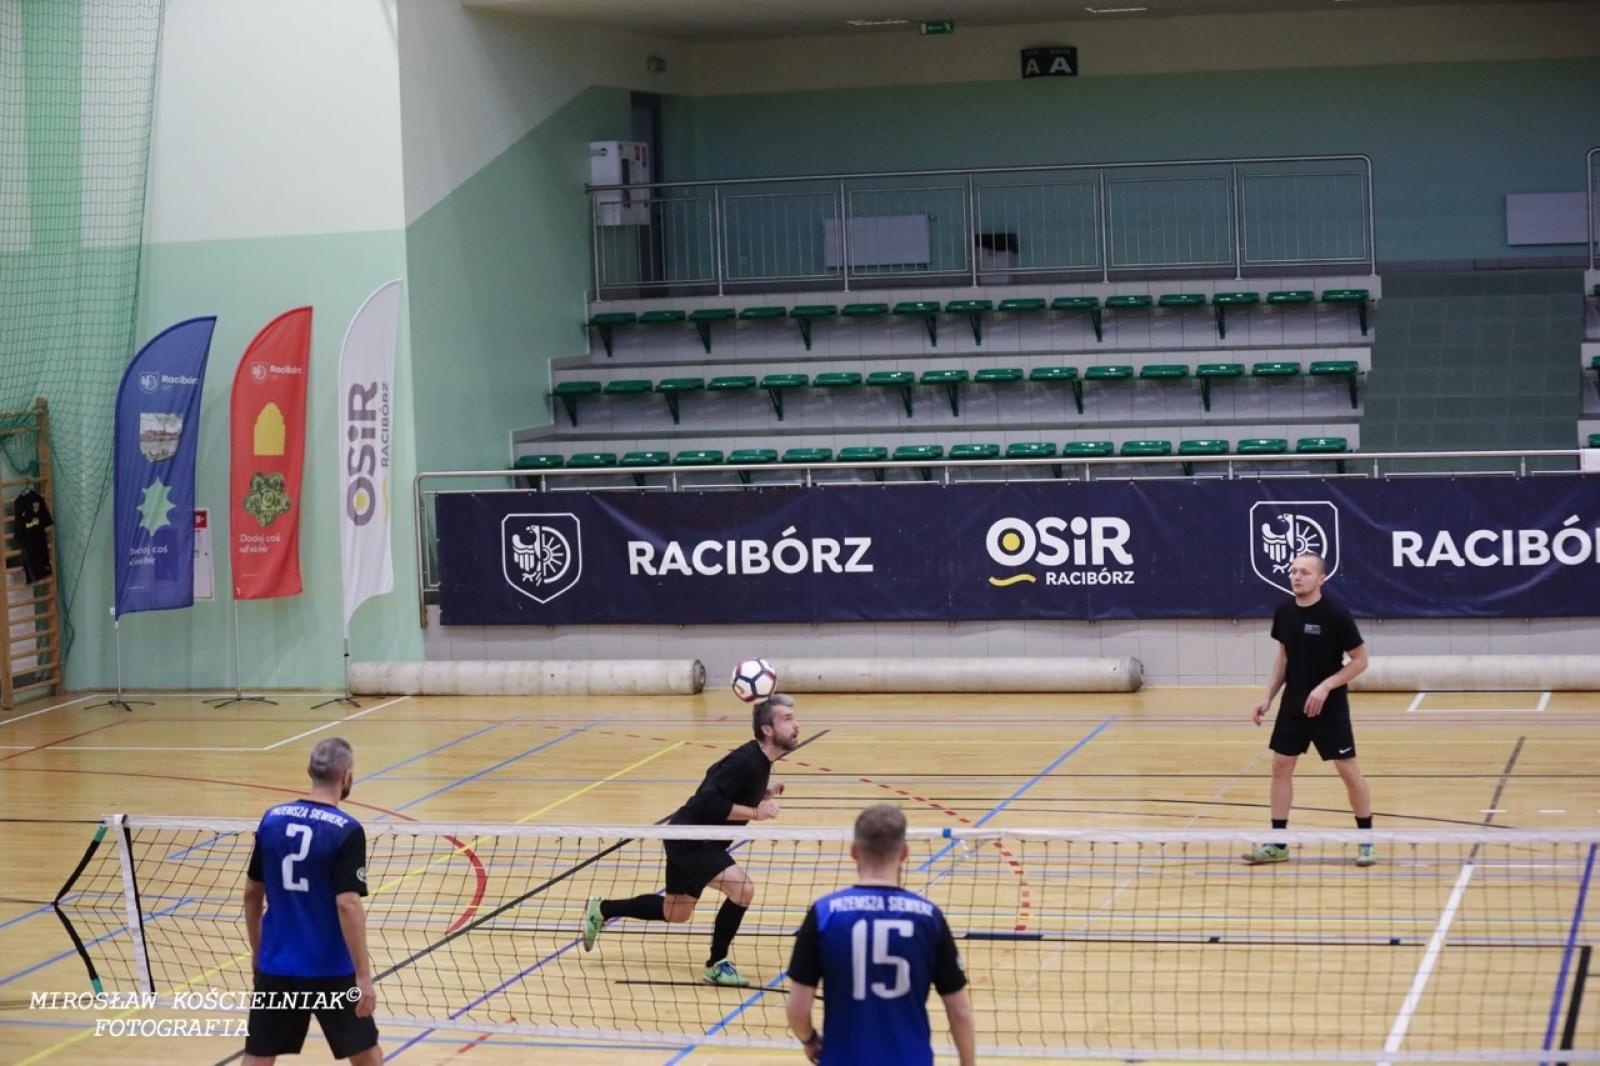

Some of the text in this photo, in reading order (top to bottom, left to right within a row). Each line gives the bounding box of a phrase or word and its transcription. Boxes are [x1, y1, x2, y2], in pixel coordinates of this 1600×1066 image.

[1025, 58, 1040, 75] A
[1049, 56, 1072, 73] A
[379, 381, 389, 467] RACIBÓRZ
[347, 381, 378, 526] OSiR
[627, 525, 874, 576] RACIBÓRZ
[986, 516, 1134, 566] OSiR
[1392, 514, 1600, 567] RACIBÓ
[1045, 567, 1135, 585] RACIBÓRZ
[282, 823, 313, 892] 2
[851, 918, 914, 1000] 15
